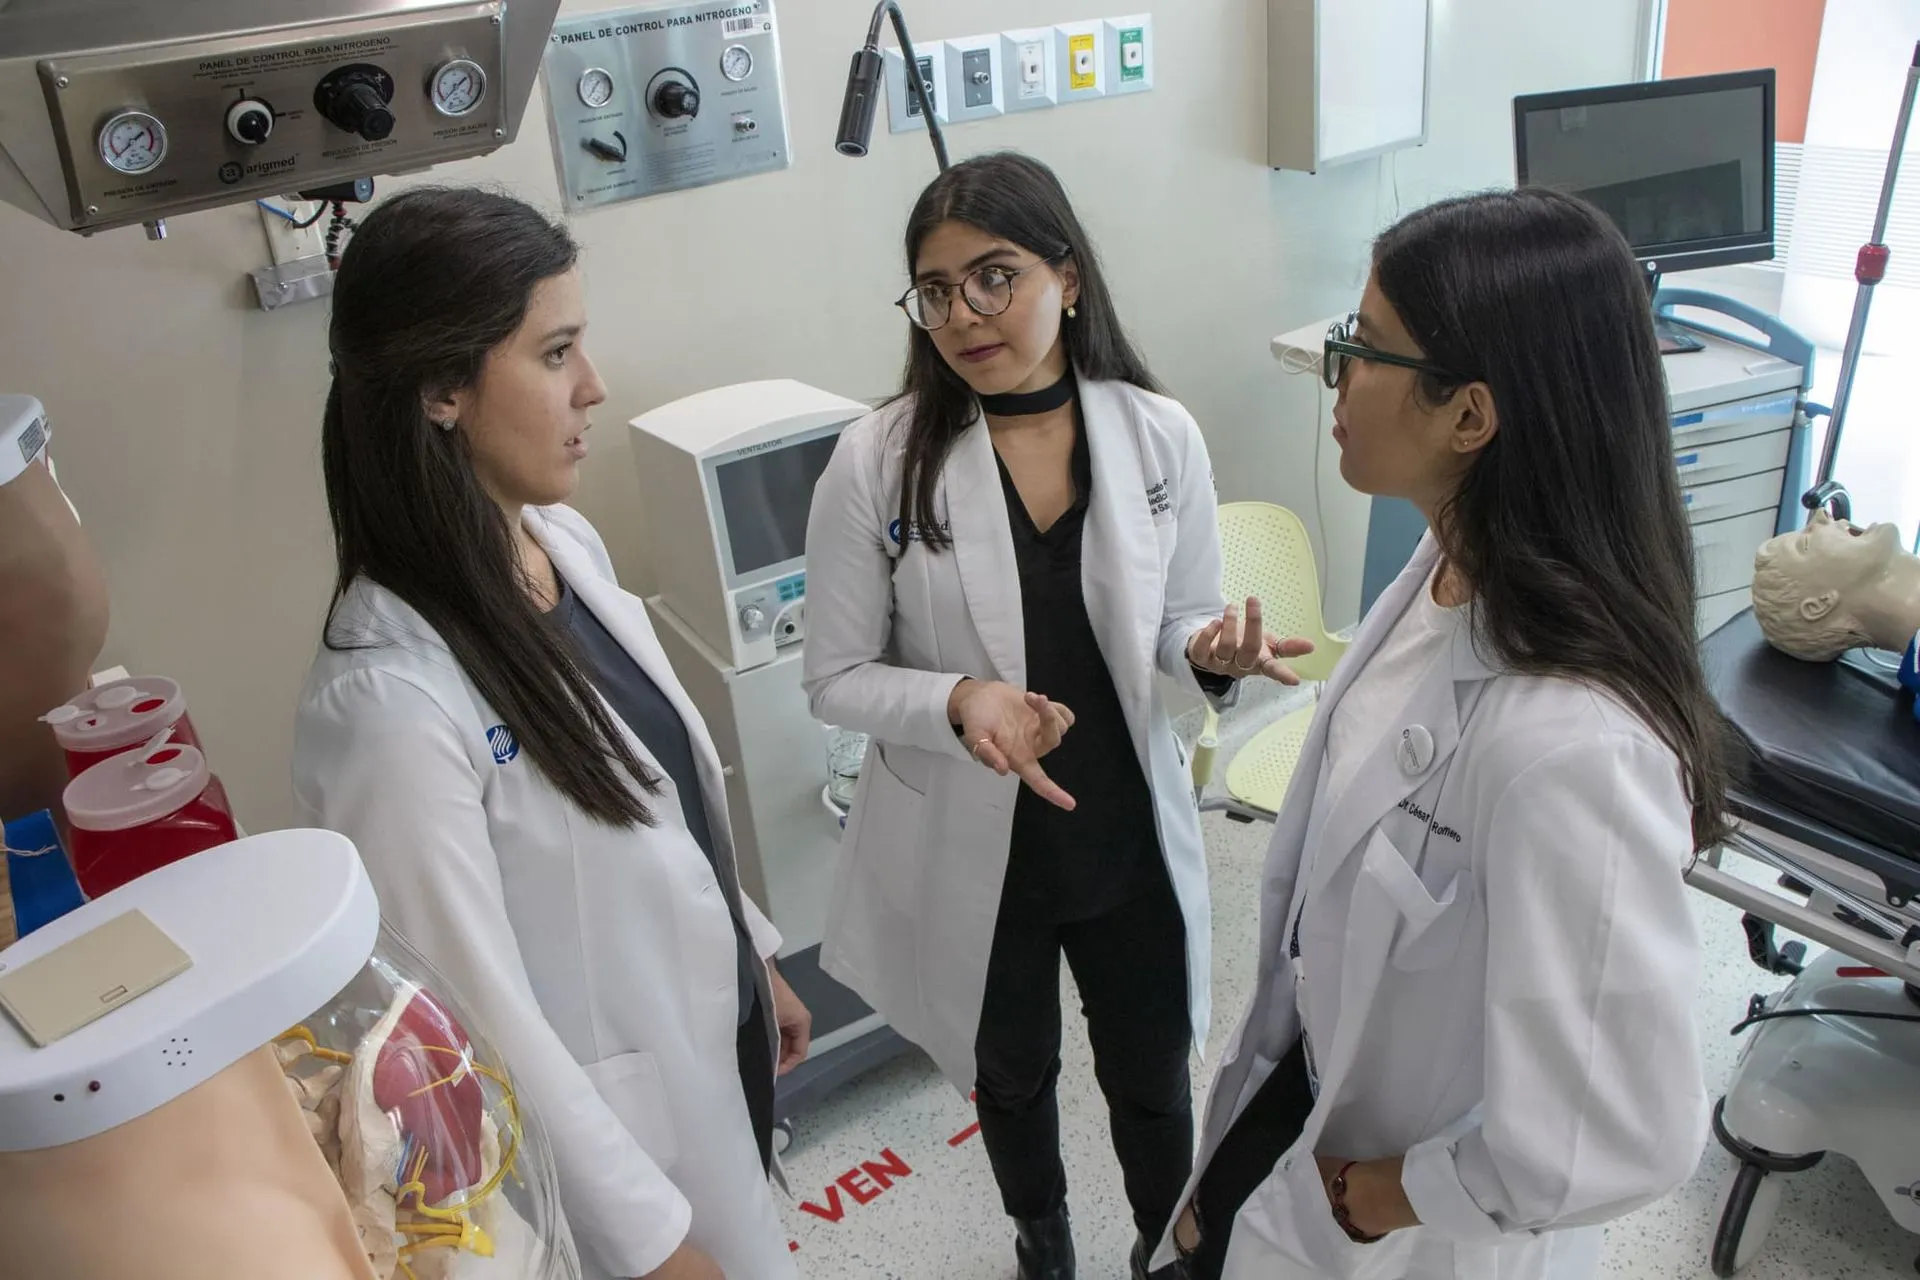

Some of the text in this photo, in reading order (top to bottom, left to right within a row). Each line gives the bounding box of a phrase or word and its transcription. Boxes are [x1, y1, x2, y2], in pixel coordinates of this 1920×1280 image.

[561, 5, 752, 44] PANEL DE CONTROL PARA NITRÓGENO
[199, 60, 232, 71] PANEL
[236, 57, 250, 66] DE
[253, 50, 300, 64] CONTROL
[304, 46, 332, 56] PARA
[246, 155, 295, 175] arigmed
[737, 438, 783, 456] VENTILATOR
[1409, 804, 1430, 822] César
[1431, 820, 1461, 843] Romero
[798, 1147, 913, 1222] VEN
